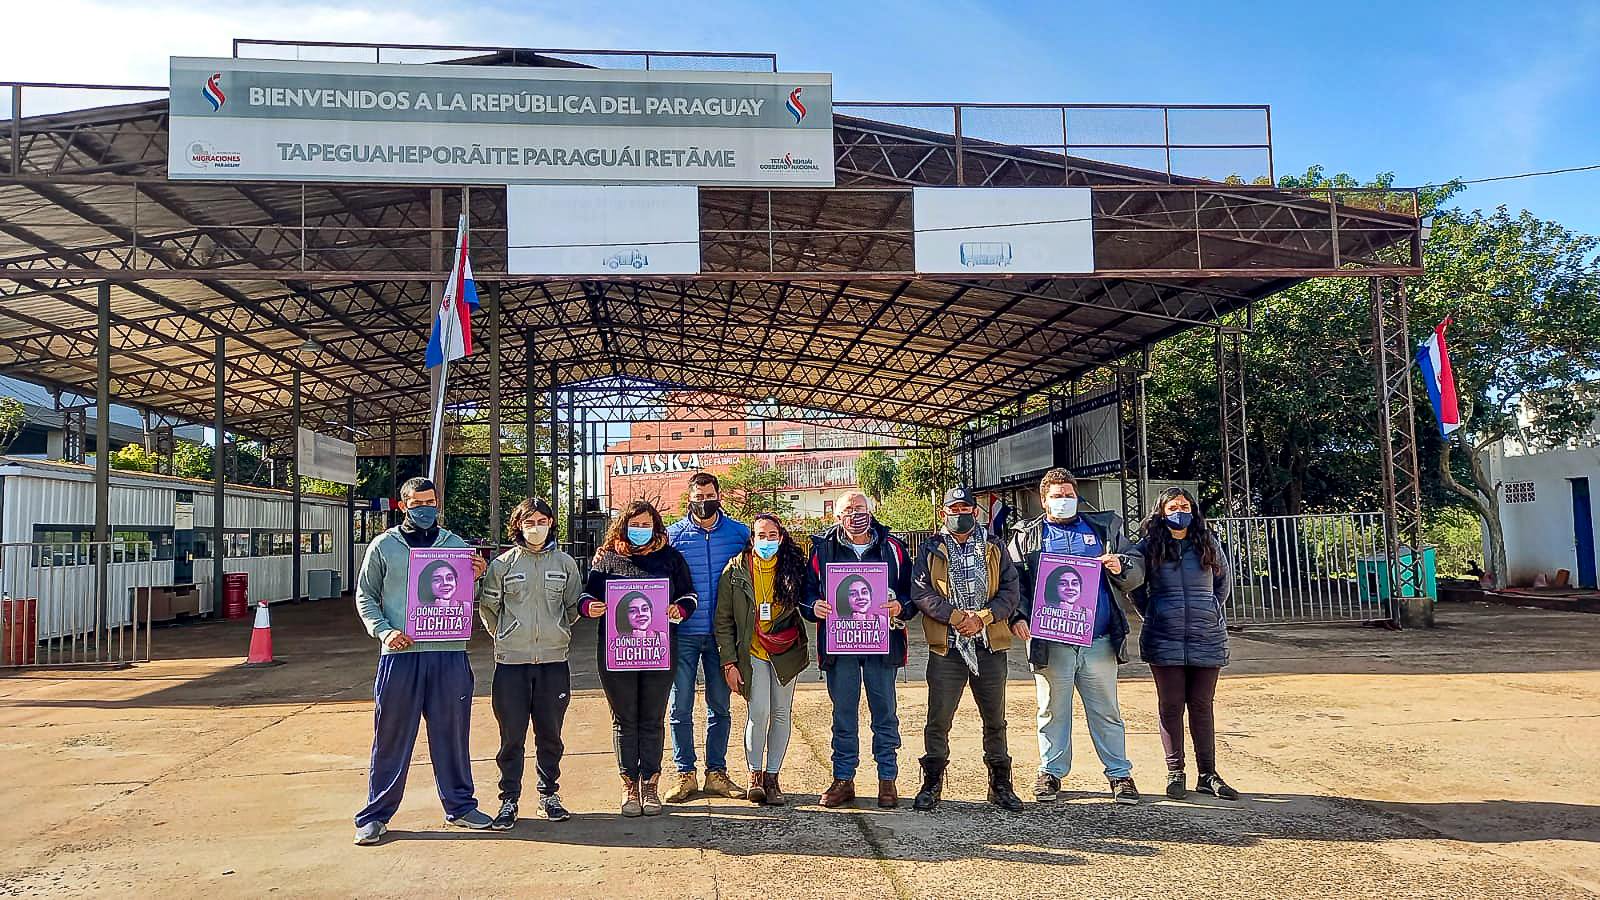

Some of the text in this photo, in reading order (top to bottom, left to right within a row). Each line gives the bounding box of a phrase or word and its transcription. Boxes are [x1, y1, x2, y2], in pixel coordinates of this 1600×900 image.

[249, 87, 765, 117] BIENVENIDOS A LA REPÚBLICA DEL PARAGUAY
[277, 142, 736, 167] TAPEGUAHEPORÃITE PARAGUÁI RETÃME
[610, 452, 703, 477] ALASKA
